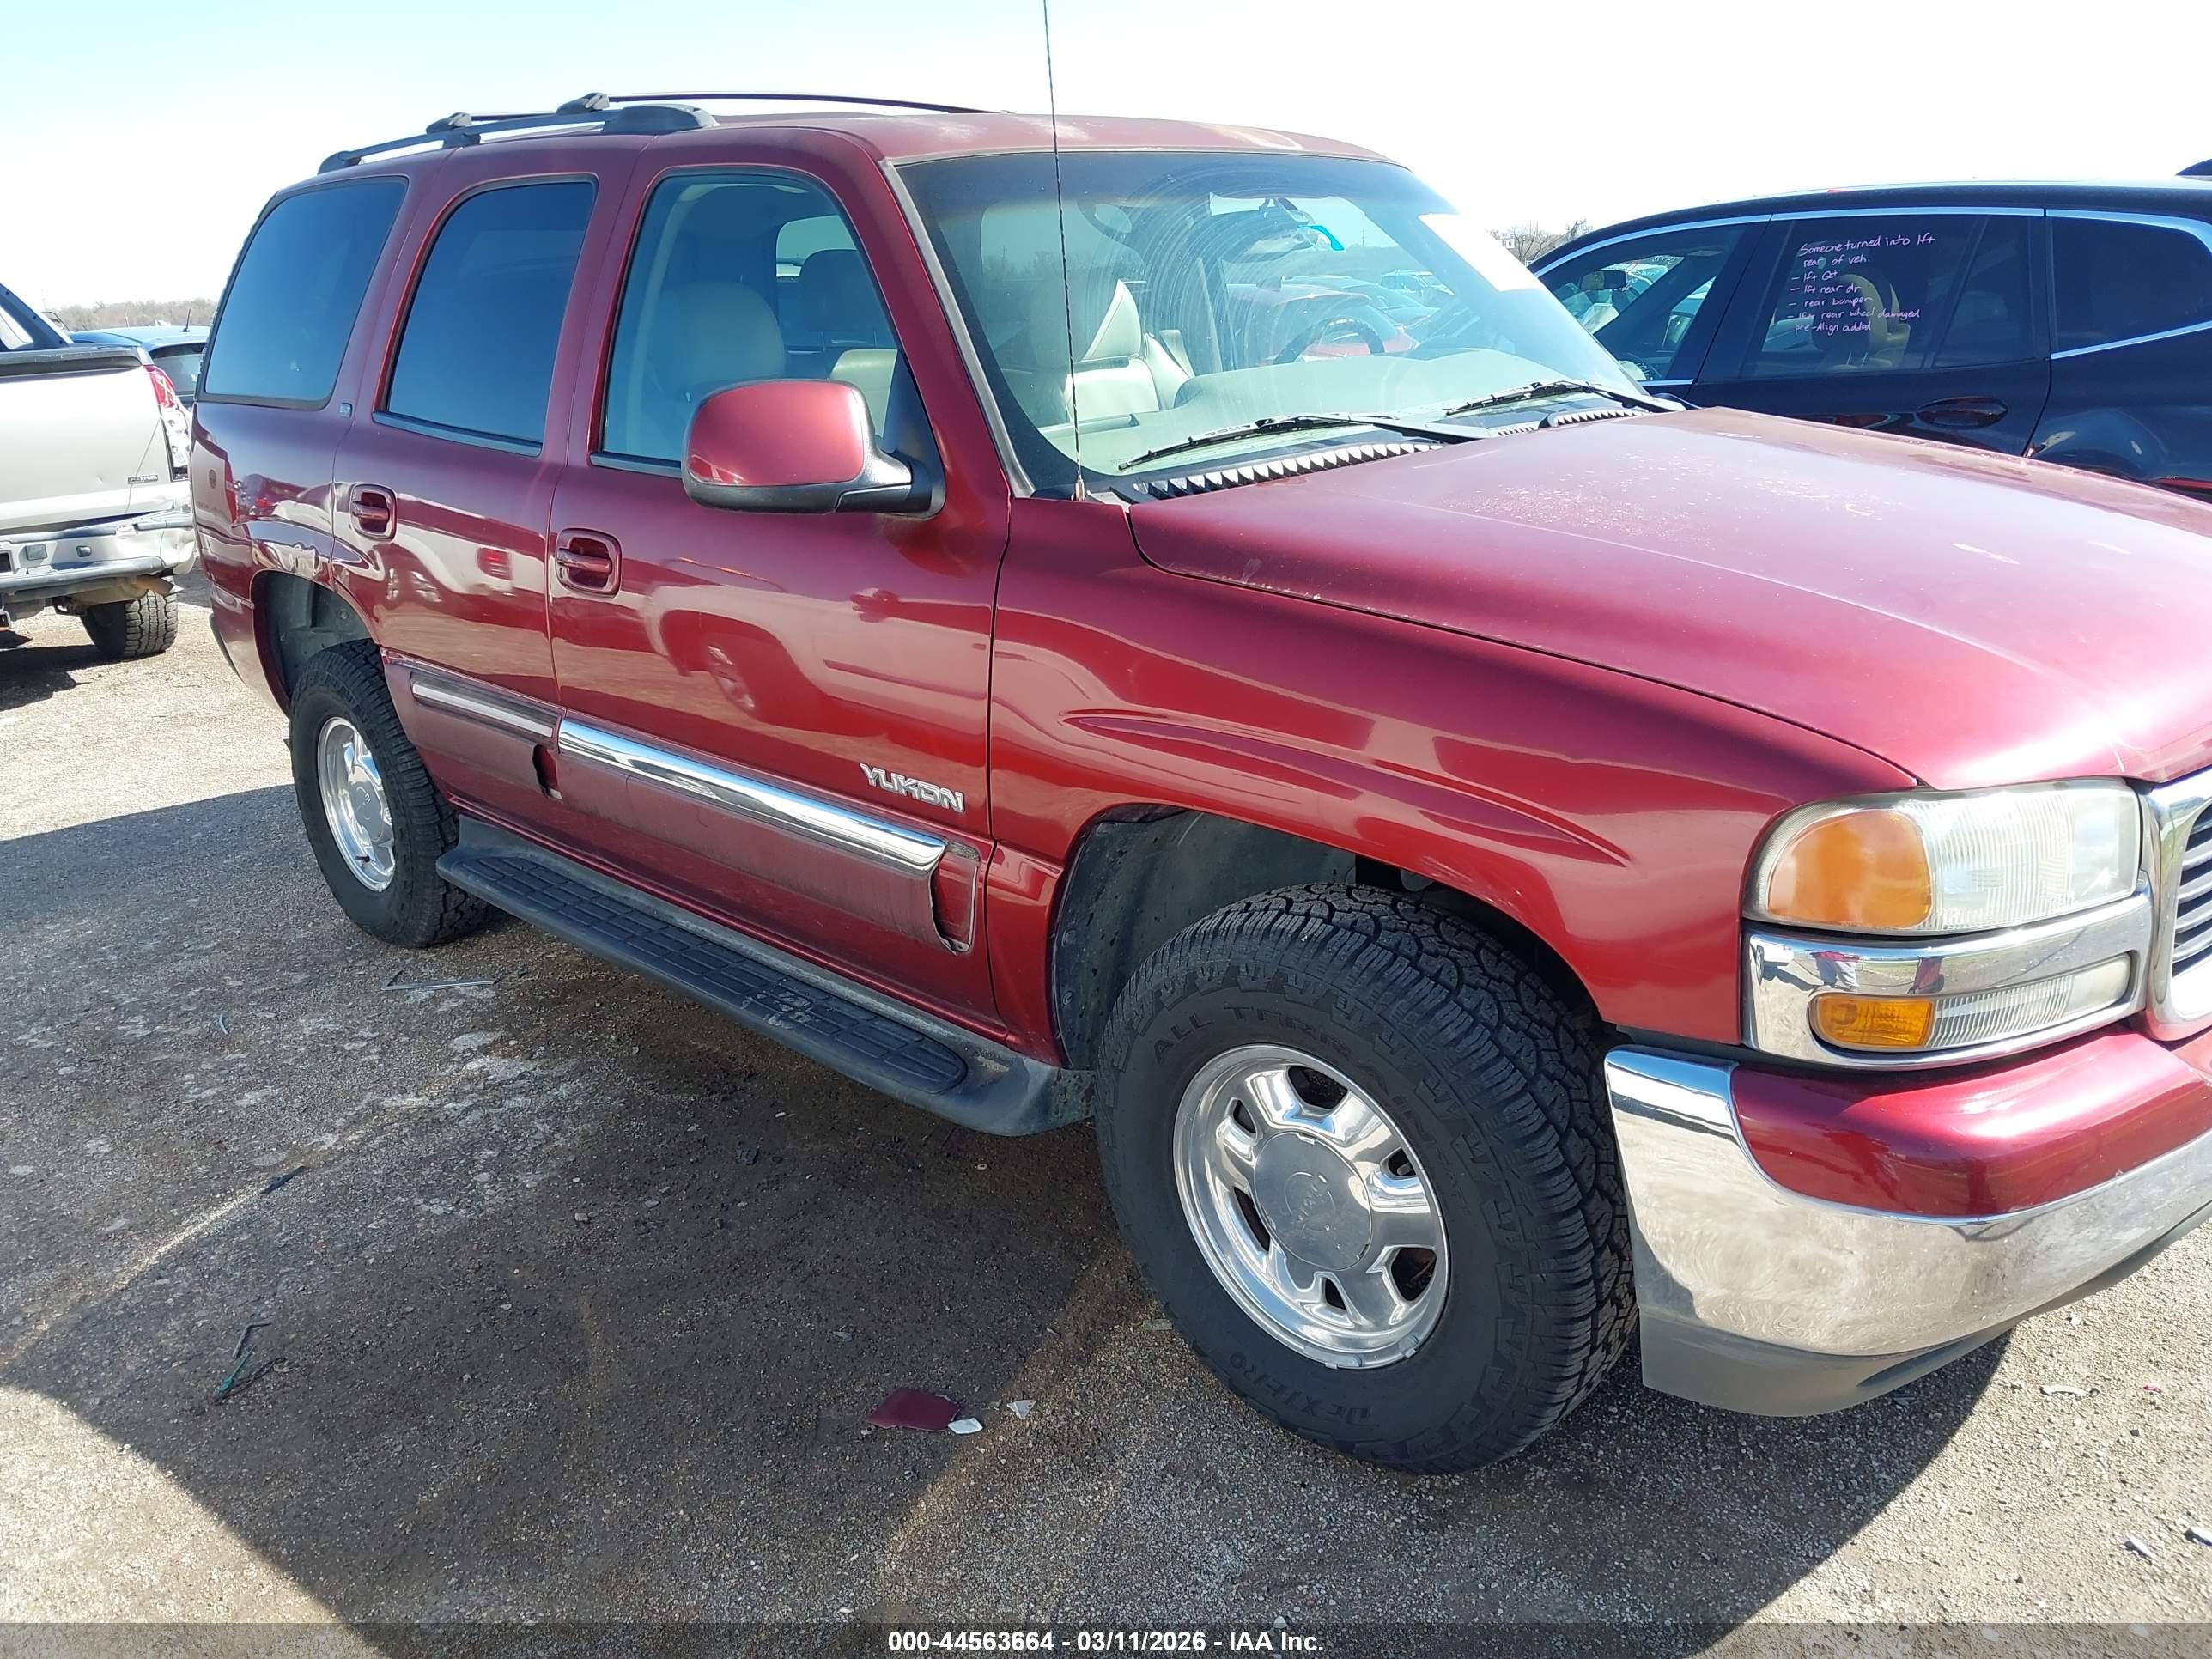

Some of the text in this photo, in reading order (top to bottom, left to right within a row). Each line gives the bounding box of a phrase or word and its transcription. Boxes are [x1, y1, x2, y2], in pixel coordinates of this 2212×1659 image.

[1798, 243, 1843, 257] Someone
[1844, 235, 1881, 251] turned
[1885, 234, 1911, 246] into
[1803, 258, 1824, 268] rear
[1831, 254, 1845, 266] of
[1820, 284, 1844, 294] rear
[1846, 282, 1863, 293] dr
[1804, 299, 1827, 307] rear
[1849, 307, 1875, 317] wheel
[1877, 308, 1920, 320] damaged
[860, 763, 965, 813] YUKON
[1153, 1012, 1215, 1063] ALL
